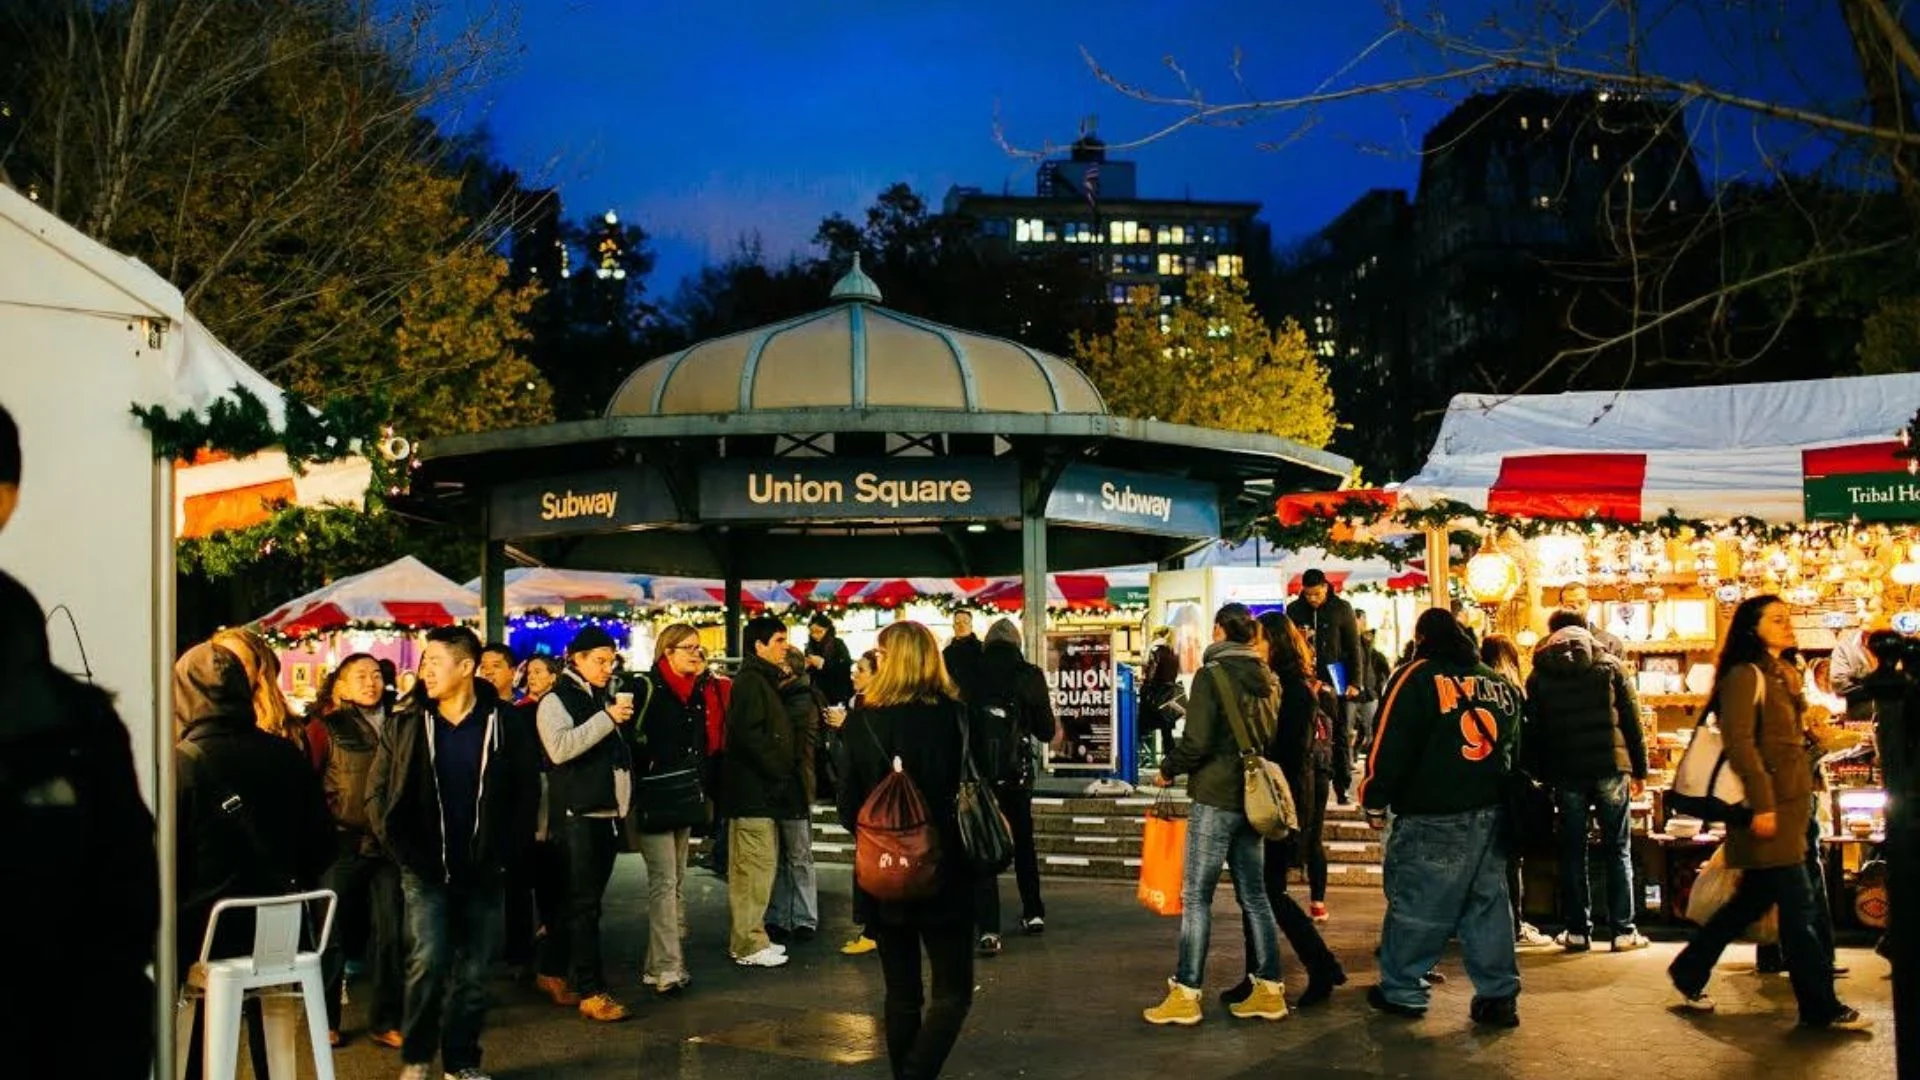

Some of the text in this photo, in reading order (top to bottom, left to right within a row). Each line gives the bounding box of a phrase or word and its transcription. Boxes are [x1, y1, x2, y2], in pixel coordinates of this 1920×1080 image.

[541, 490, 618, 521] Subway
[748, 472, 972, 508] Union Square
[1101, 482, 1172, 521] Subway
[1847, 486, 1894, 503] Tribal
[1046, 670, 1112, 688] UNION
[1461, 708, 1497, 761] 9
